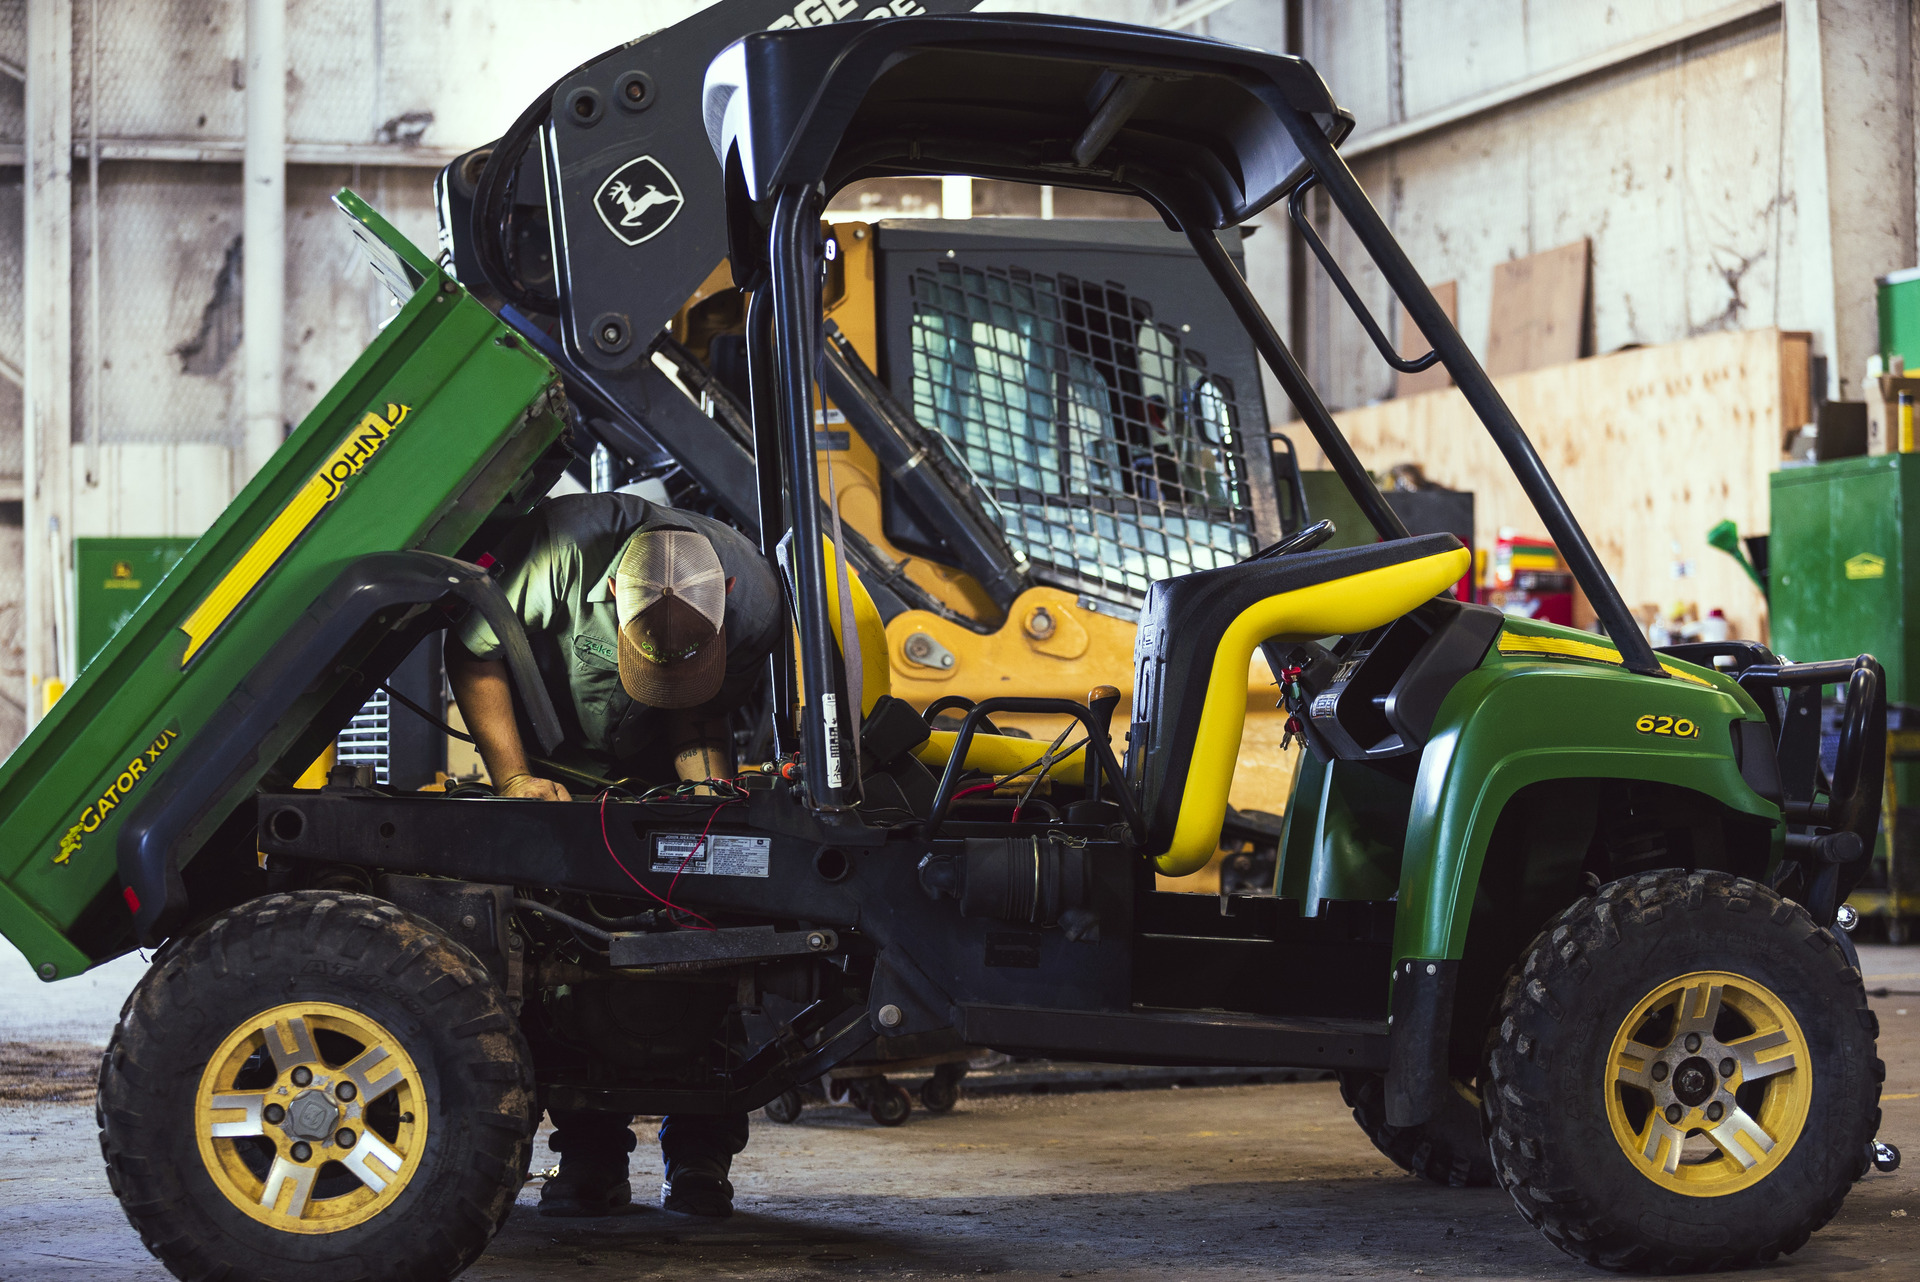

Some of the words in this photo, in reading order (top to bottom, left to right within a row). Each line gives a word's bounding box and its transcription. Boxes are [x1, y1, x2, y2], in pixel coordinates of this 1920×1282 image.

[320, 423, 385, 499] JOHN
[583, 640, 613, 657] Zeke
[1636, 714, 1700, 738] 620i
[679, 748, 698, 762] 1948
[80, 758, 148, 832] GATOR
